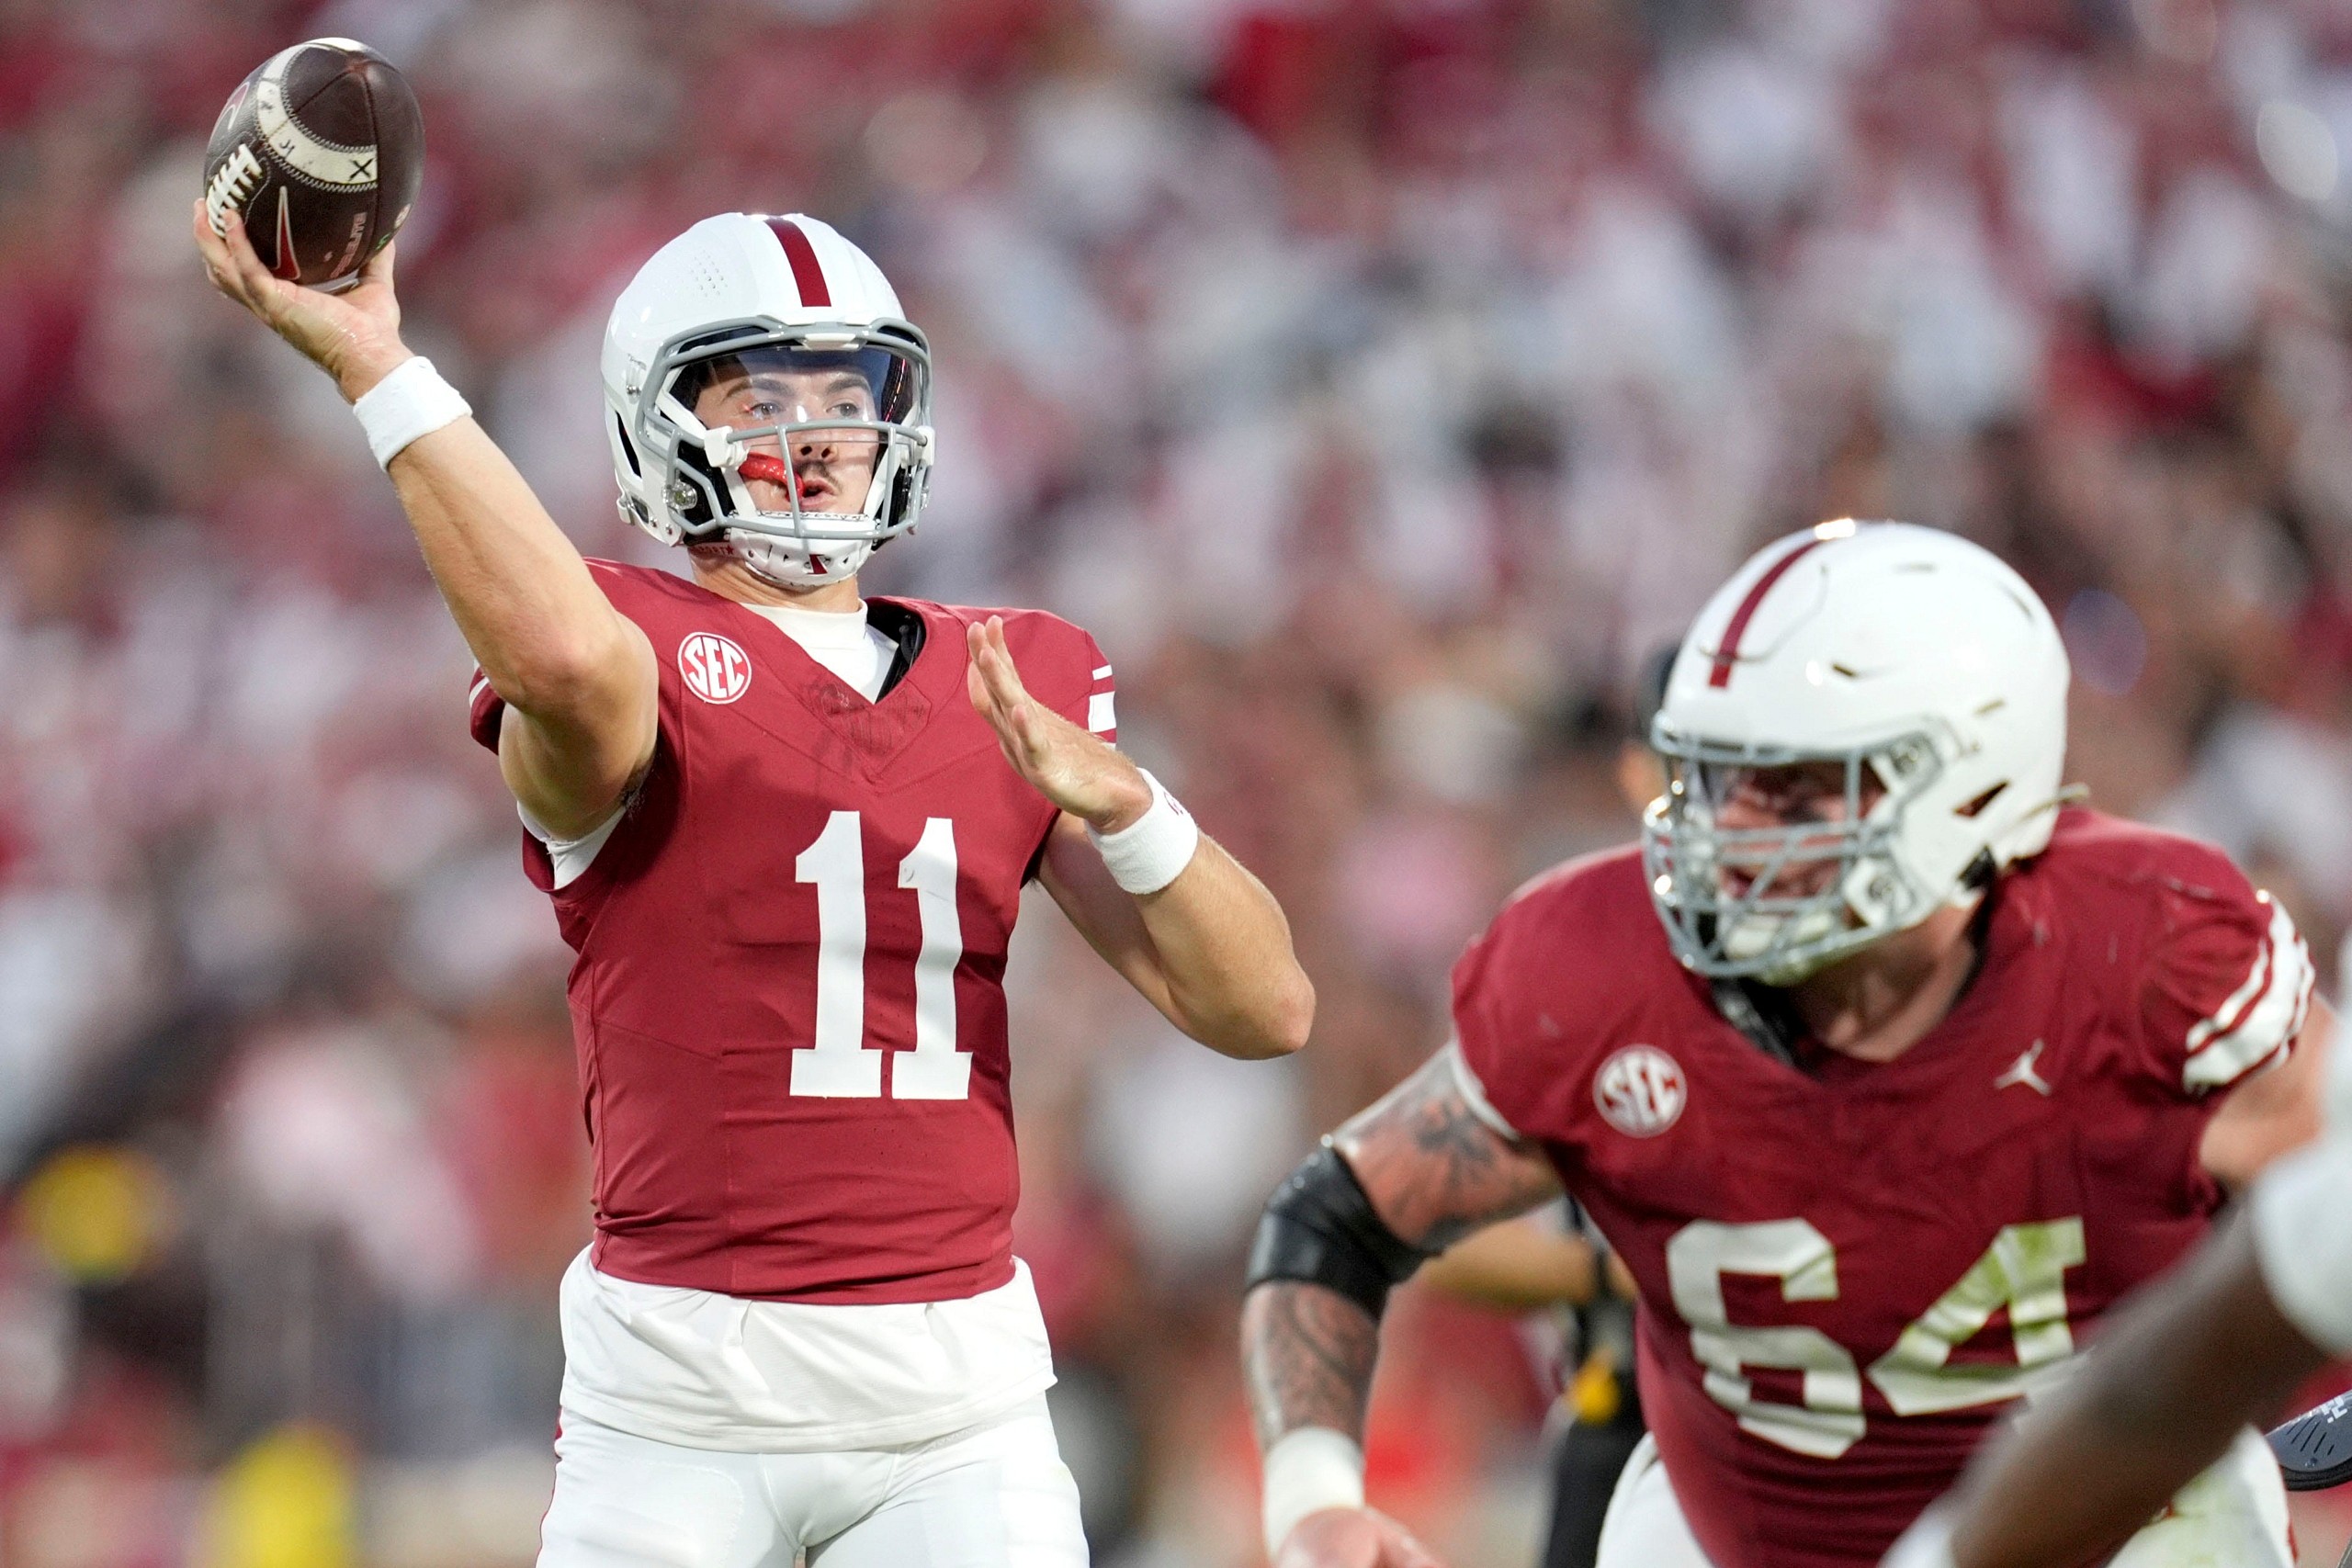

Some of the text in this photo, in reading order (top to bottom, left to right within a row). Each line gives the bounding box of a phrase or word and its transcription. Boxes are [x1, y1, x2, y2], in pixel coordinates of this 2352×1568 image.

[684, 636, 745, 699] SEC
[789, 810, 973, 1100] 11
[1602, 1052, 1678, 1128] SEC
[1666, 1216, 2086, 1460] 64
